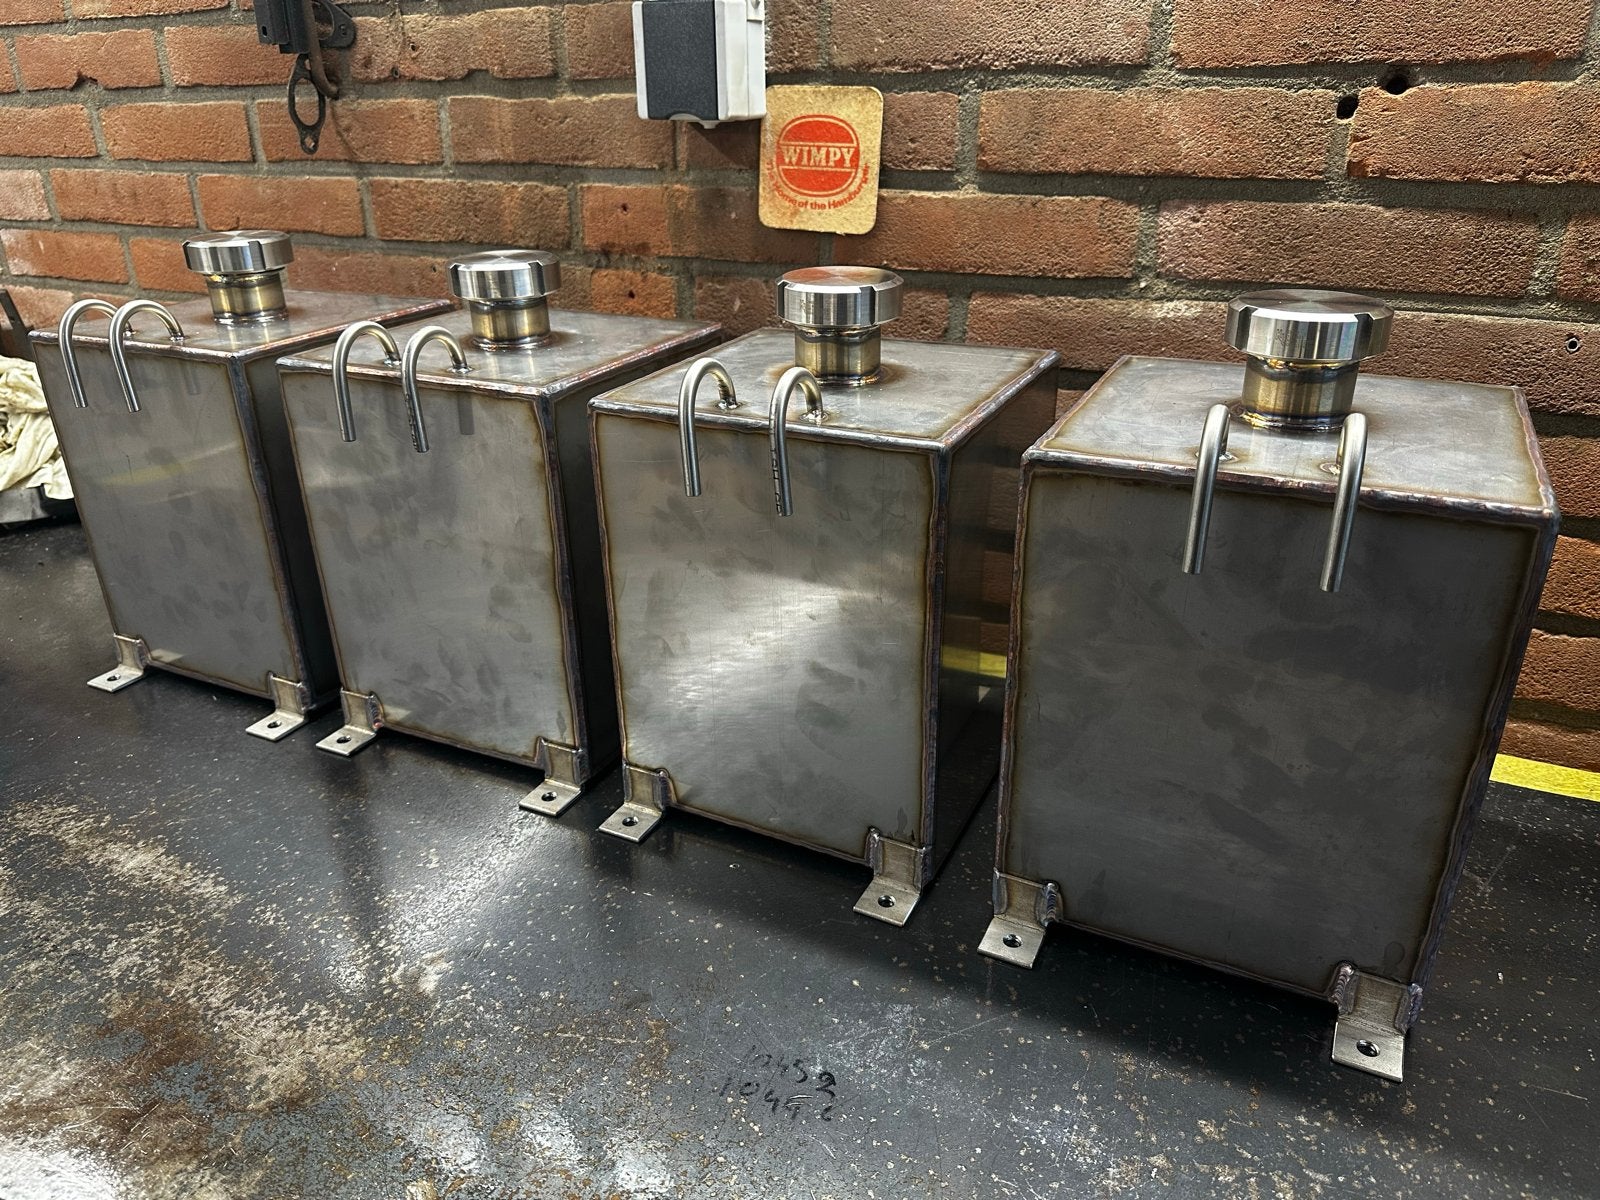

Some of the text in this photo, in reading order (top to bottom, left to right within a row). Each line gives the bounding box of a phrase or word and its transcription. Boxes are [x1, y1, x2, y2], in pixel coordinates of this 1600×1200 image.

[780, 146, 856, 168] WIMPY
[798, 199, 809, 209] of
[810, 199, 827, 211] the
